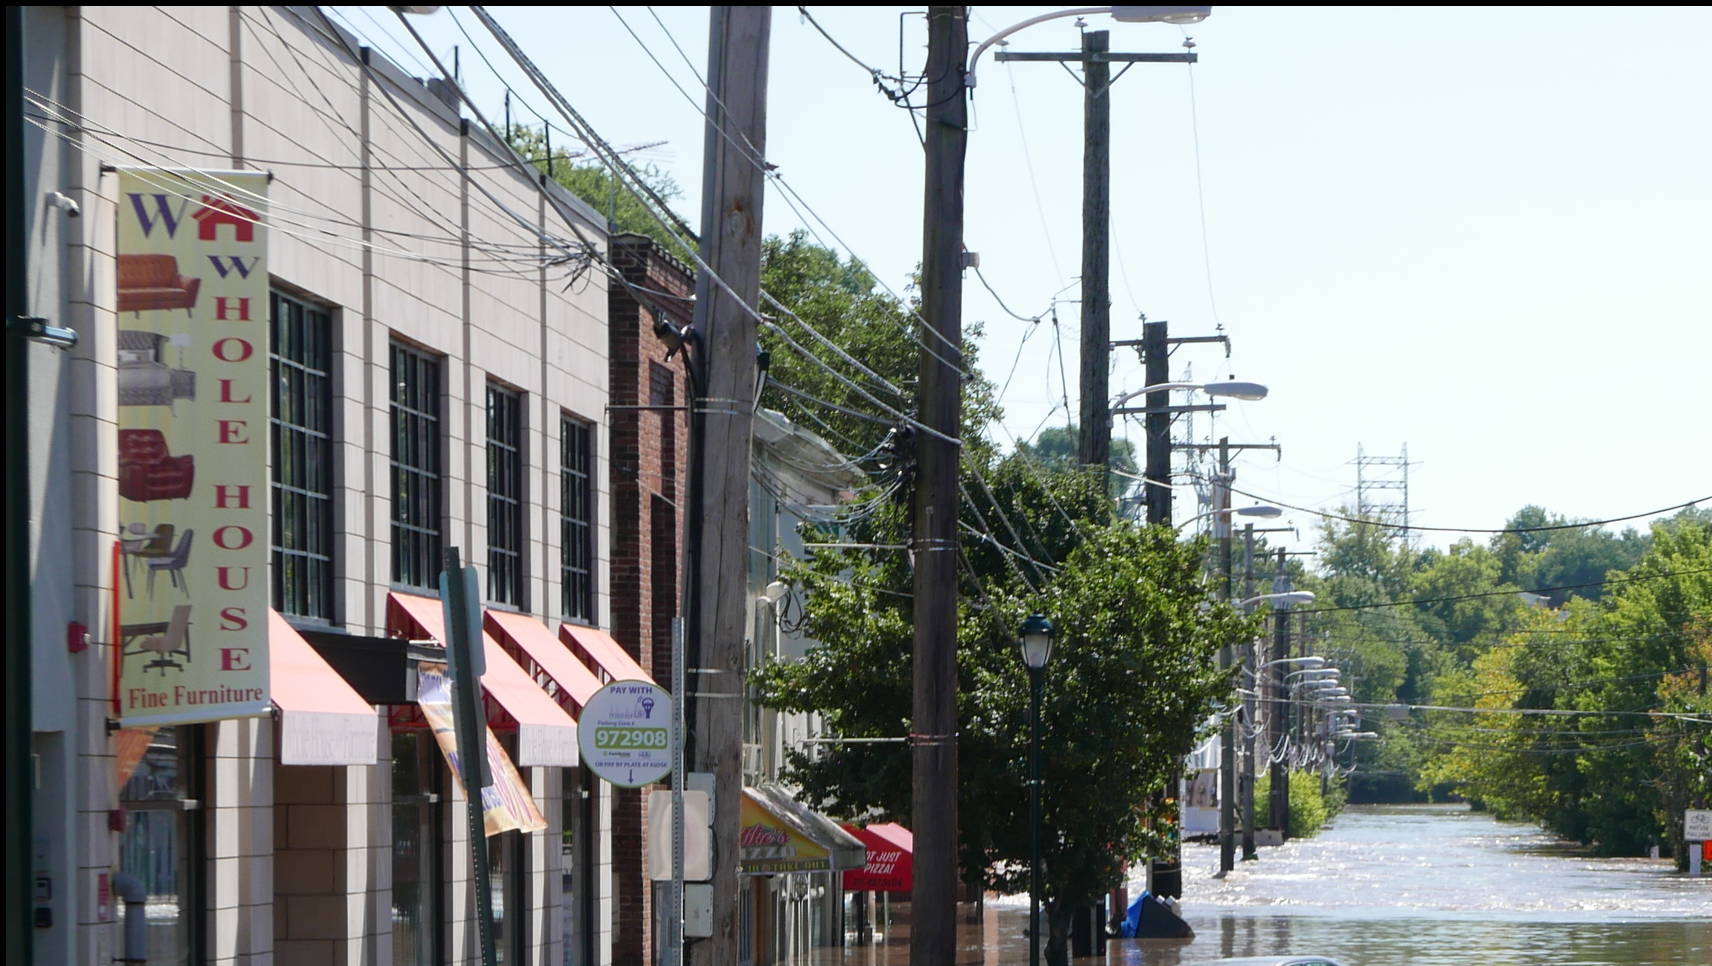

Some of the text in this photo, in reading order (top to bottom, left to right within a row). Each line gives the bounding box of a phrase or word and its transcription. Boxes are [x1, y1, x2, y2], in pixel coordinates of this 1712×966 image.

[206, 255, 261, 672] WHOLE HOUSE
[128, 684, 263, 710] Fine Furniture
[610, 686, 653, 695] PAY WITH
[596, 730, 667, 747] 972908
[876, 851, 902, 863] JUST
[864, 863, 895, 875] PIZZA!
